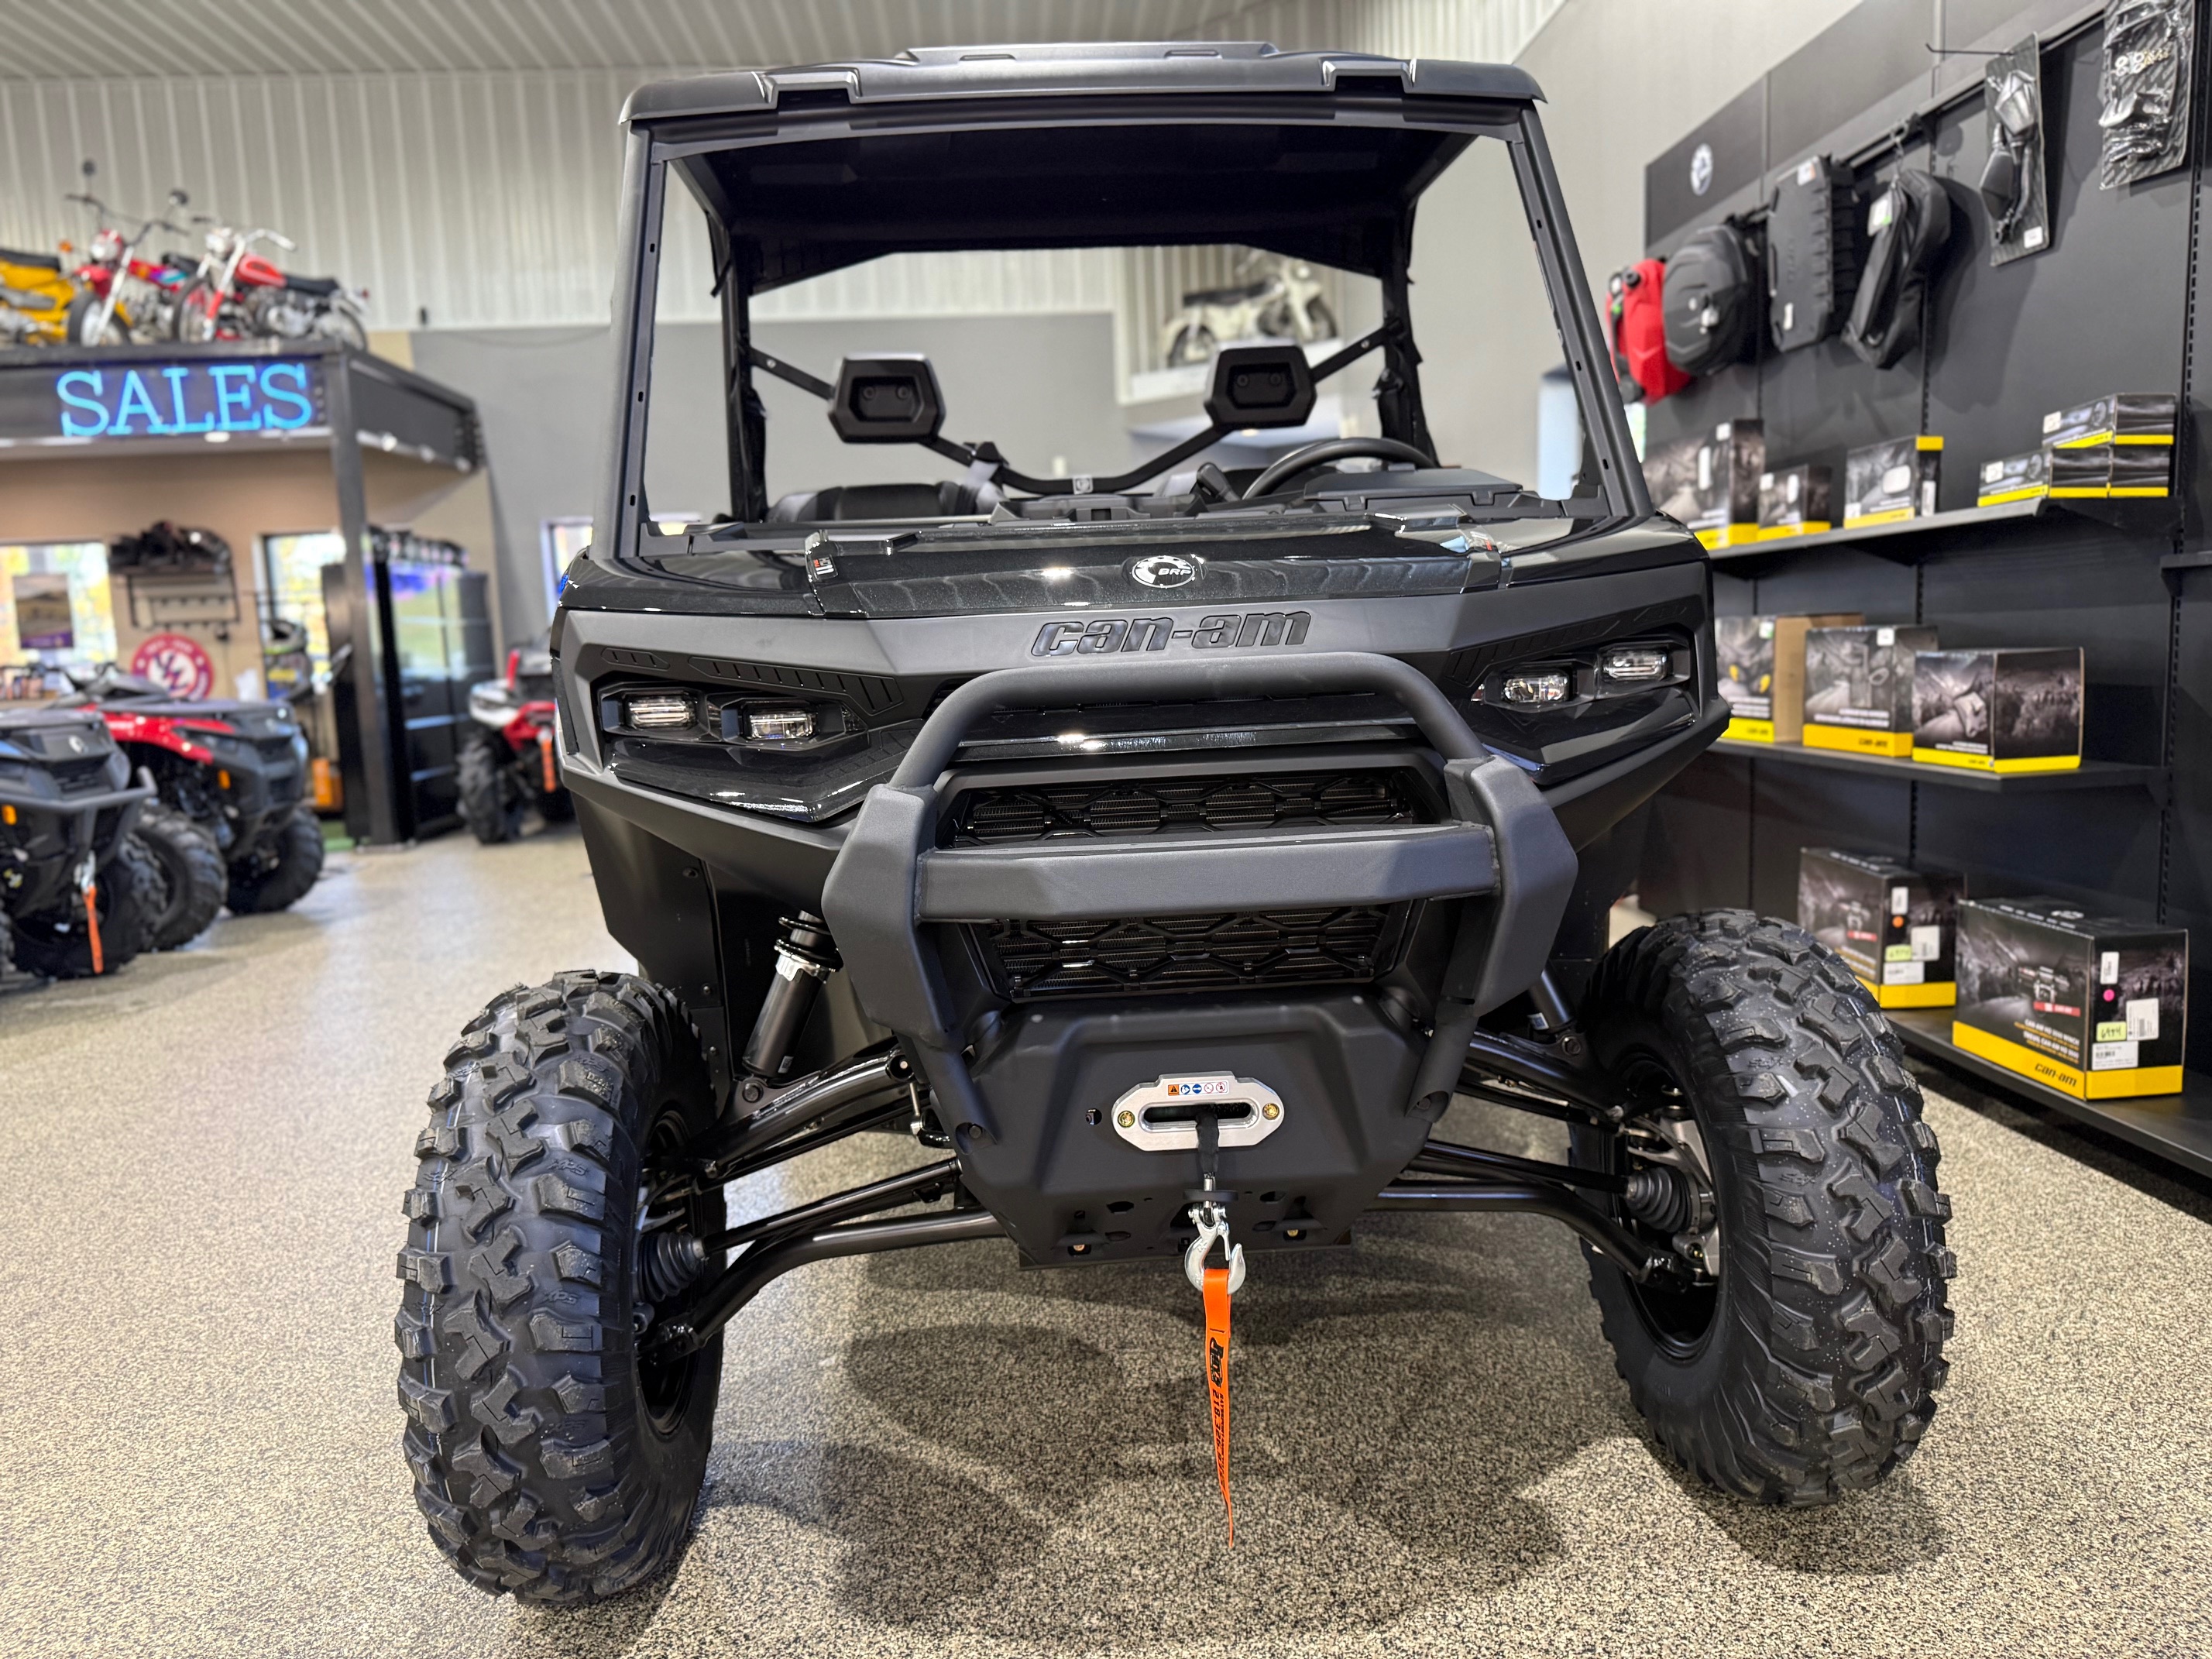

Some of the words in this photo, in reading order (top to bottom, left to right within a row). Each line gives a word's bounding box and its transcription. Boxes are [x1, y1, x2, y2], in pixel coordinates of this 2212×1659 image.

[57, 362, 312, 438] SALES
[1157, 567, 1193, 576] BRP
[1030, 610, 1312, 658] can-am
